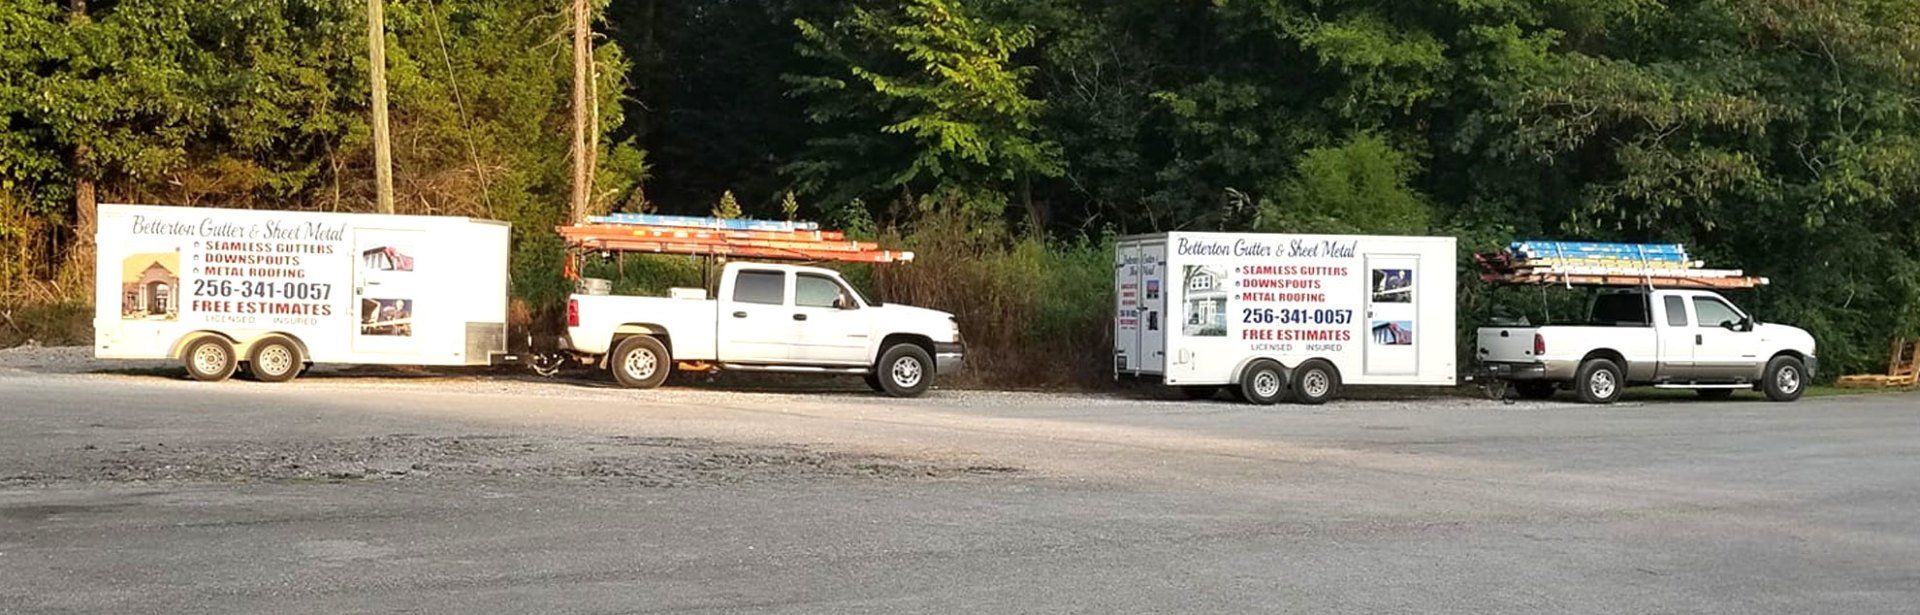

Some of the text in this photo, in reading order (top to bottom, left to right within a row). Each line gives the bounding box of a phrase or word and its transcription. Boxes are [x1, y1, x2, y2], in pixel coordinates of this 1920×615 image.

[132, 215, 347, 242] Betterton Gutter & Sheet Metal
[206, 241, 334, 254] SEAMLESS GUTTERS
[1178, 238, 1357, 258] Betterton Gutter & Sheet Metal
[205, 255, 300, 265] DOWNSPOUTS
[205, 267, 305, 278] METAL ROOFING
[1243, 266, 1348, 276] SEAMLESS GUTTERS
[1243, 279, 1321, 288] DOWNSPOUTS
[194, 279, 332, 300] 256-341-0057
[1243, 293, 1325, 302] METAL ROOFING
[193, 300, 331, 316] FREE ESTIMATES
[273, 317, 317, 325] INSURED
[1243, 308, 1352, 324] 256-341-0057
[1243, 330, 1350, 341] FREE ESTIMATES
